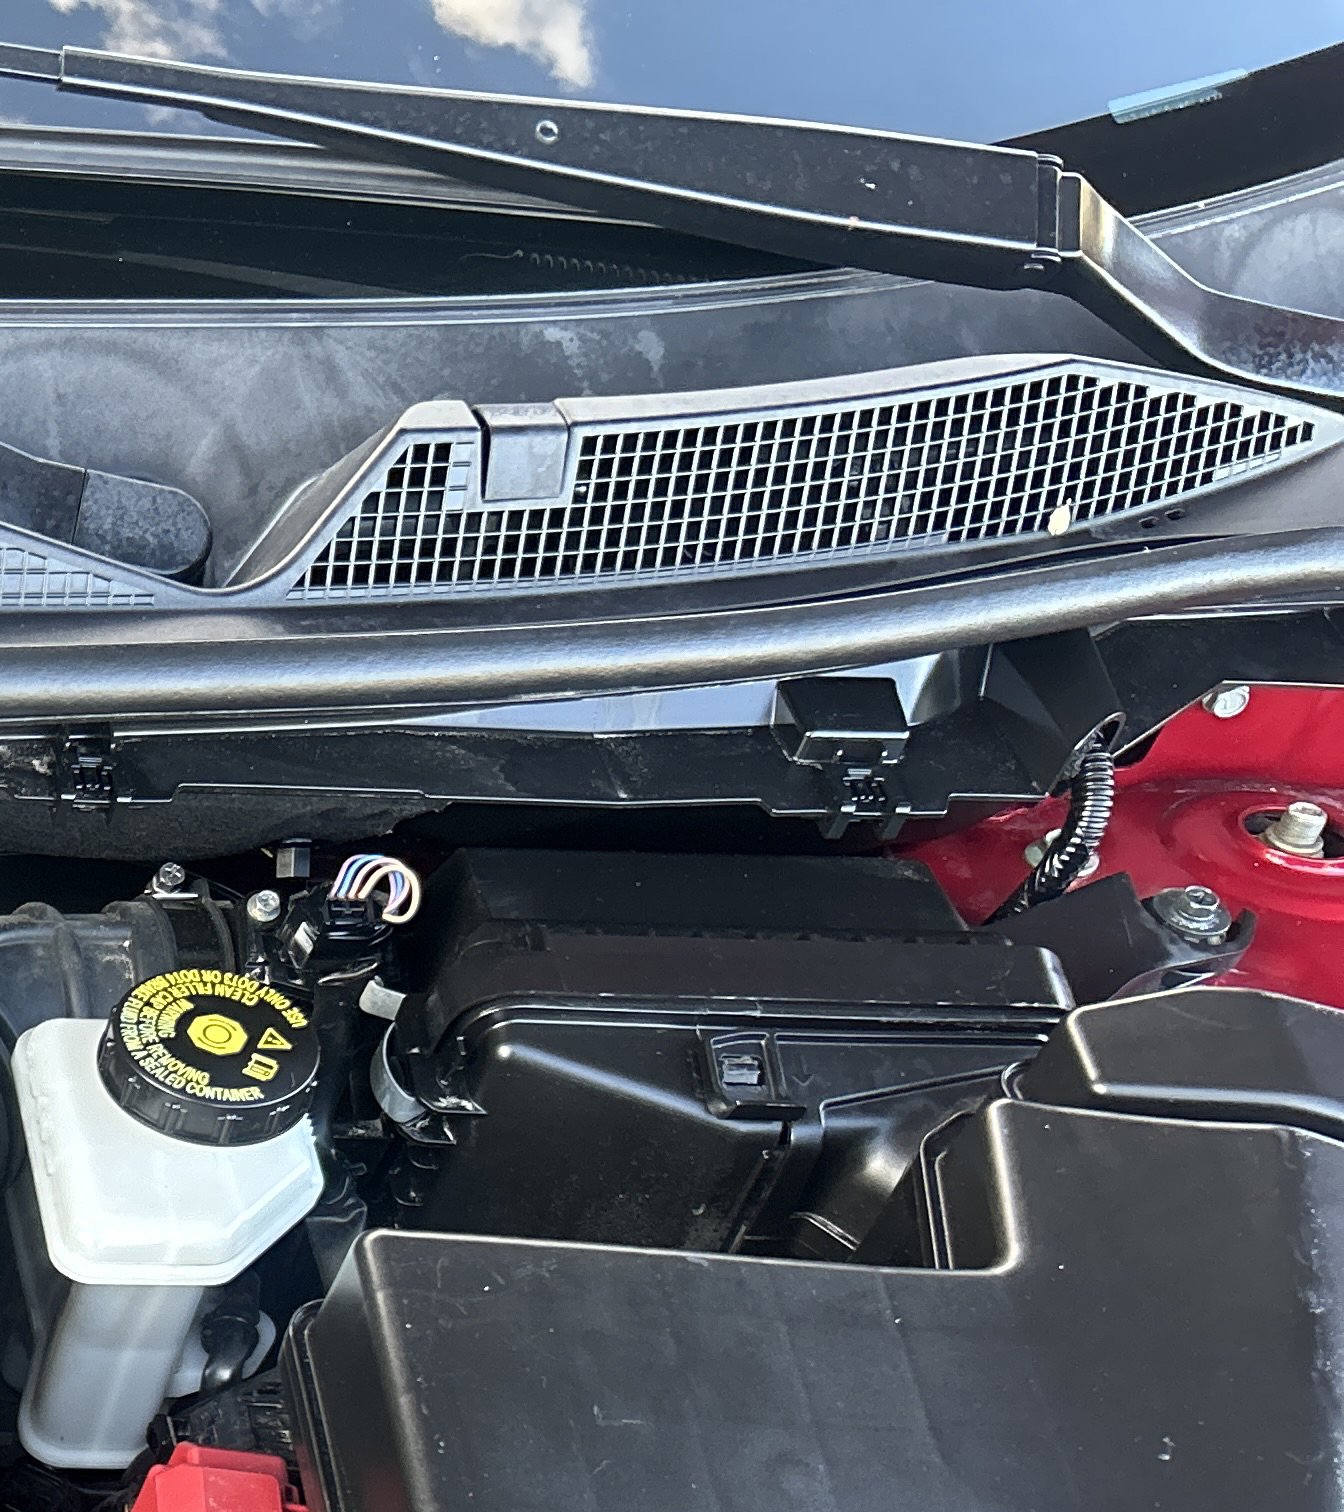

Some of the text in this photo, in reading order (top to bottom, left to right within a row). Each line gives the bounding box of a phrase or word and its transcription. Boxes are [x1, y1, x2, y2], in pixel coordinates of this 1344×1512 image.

[120, 969, 309, 1101] USE ONLY DOT3 OR DOT4 BRAKE FLUID FROM A SEALED CONTAINER
[139, 982, 259, 1086] CLEAN FILLER CAP BEFORE REMOVING
[156, 998, 195, 1039] WARNING
